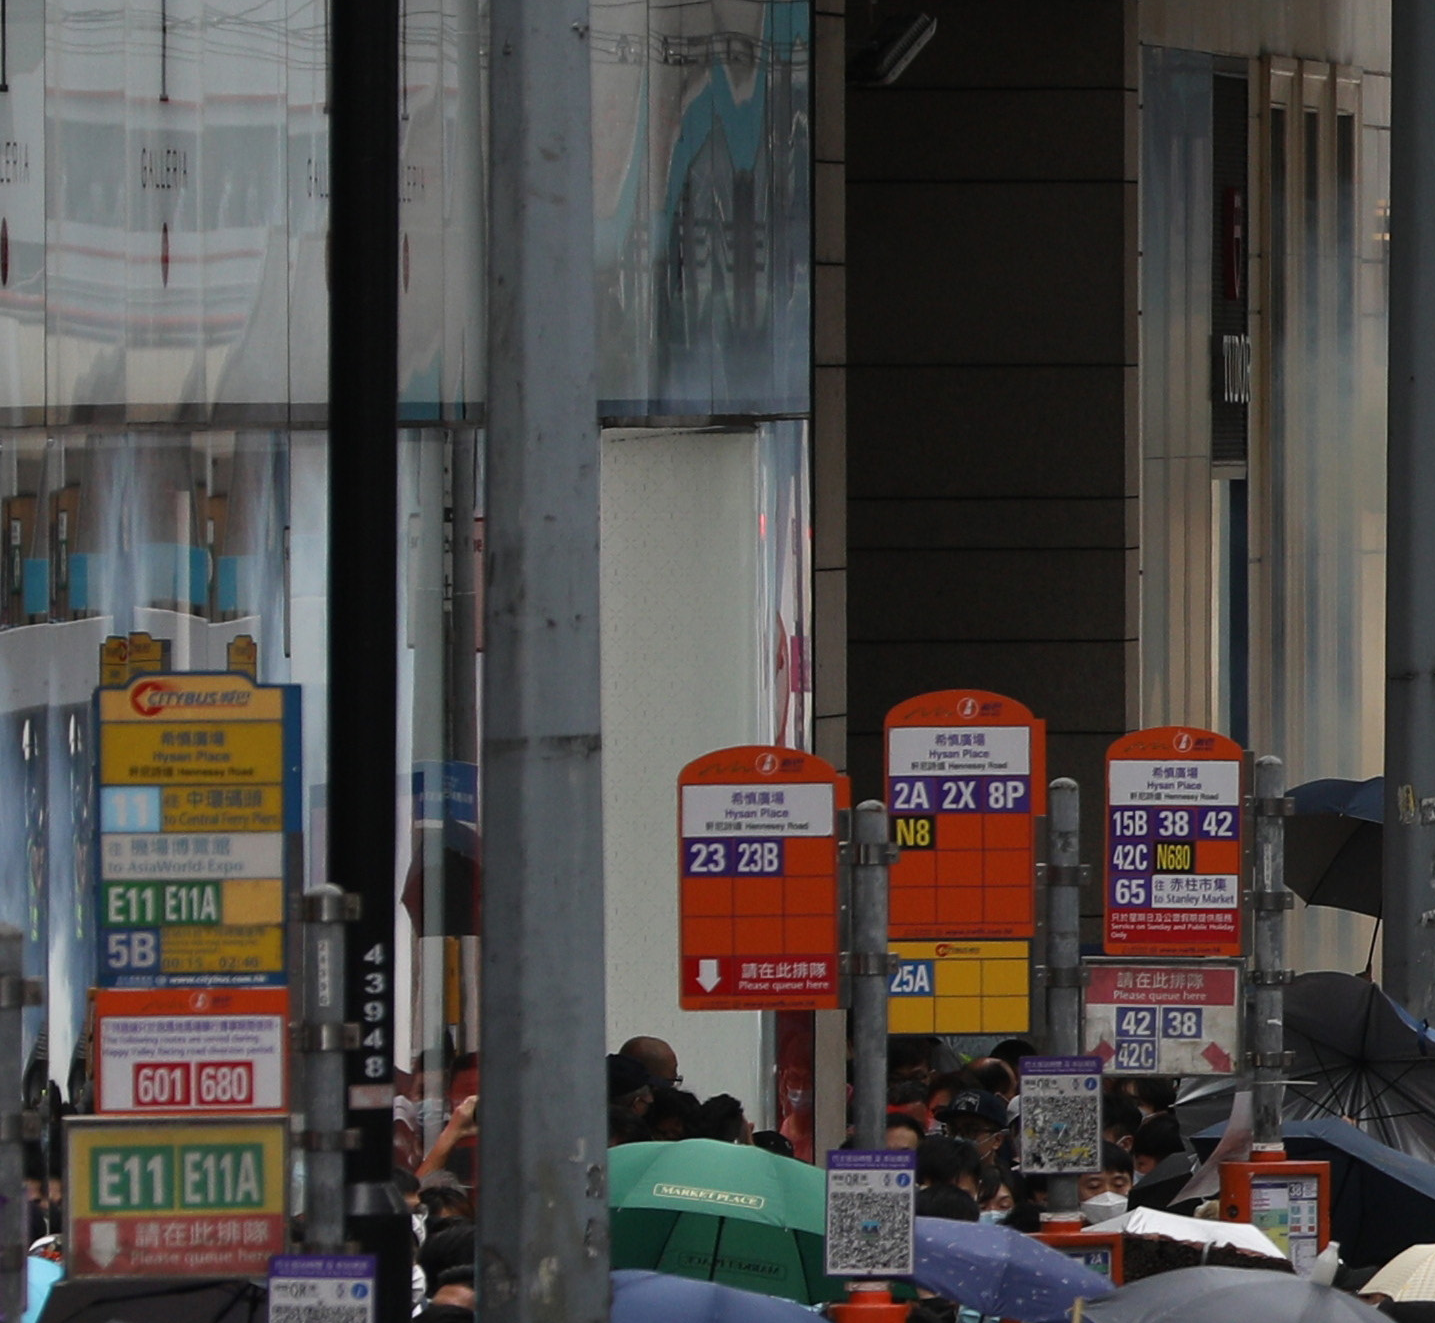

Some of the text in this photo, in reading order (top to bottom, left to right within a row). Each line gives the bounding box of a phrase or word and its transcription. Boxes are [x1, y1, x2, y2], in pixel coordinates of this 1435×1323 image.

[147, 691, 216, 707] CITYBUS
[935, 733, 985, 746] 希慎廣場
[196, 751, 231, 761] Place
[929, 749, 990, 760] Hysan Place
[948, 762, 986, 770] Hennessy
[1152, 767, 1199, 778] 希慎廣場
[1147, 781, 1202, 791] Hysan Place
[732, 792, 785, 805] 希慎廣場
[894, 781, 1025, 809] 2A 2X 8P
[1164, 792, 1199, 800] Hennessy
[113, 793, 149, 827] 11
[725, 808, 789, 819] Hysan Place
[745, 821, 809, 831] Hennessy Road
[1113, 810, 1233, 836] 15B 38 42
[896, 819, 930, 846] N8
[690, 842, 779, 873] 23 23B
[1113, 844, 1190, 870] 42C N680
[108, 861, 244, 874] to AsiaWorld-Expo
[1116, 879, 1146, 905] 65
[1170, 877, 1227, 891] 赤柱市集
[108, 885, 220, 922] E11 E11A
[1154, 893, 1234, 905] to Stanley Market
[1111, 931, 1127, 939] Only
[108, 931, 156, 969] 5B
[742, 963, 826, 979] 請在此排隊
[890, 964, 930, 992] 25A
[738, 979, 829, 992] Please queue here
[1117, 972, 1204, 989] 請在此排隊
[1113, 990, 1207, 1002] Please queue here
[1122, 1011, 1197, 1036] 42 38
[1118, 1043, 1153, 1067] 42C
[138, 1067, 247, 1103] 601 680
[99, 1151, 260, 1206] E11 E11A
[661, 1185, 758, 1205] MARKET PLACE
[135, 1221, 270, 1248] 請在此排隊
[130, 1249, 179, 1265] Please
[184, 1252, 233, 1265] queue
